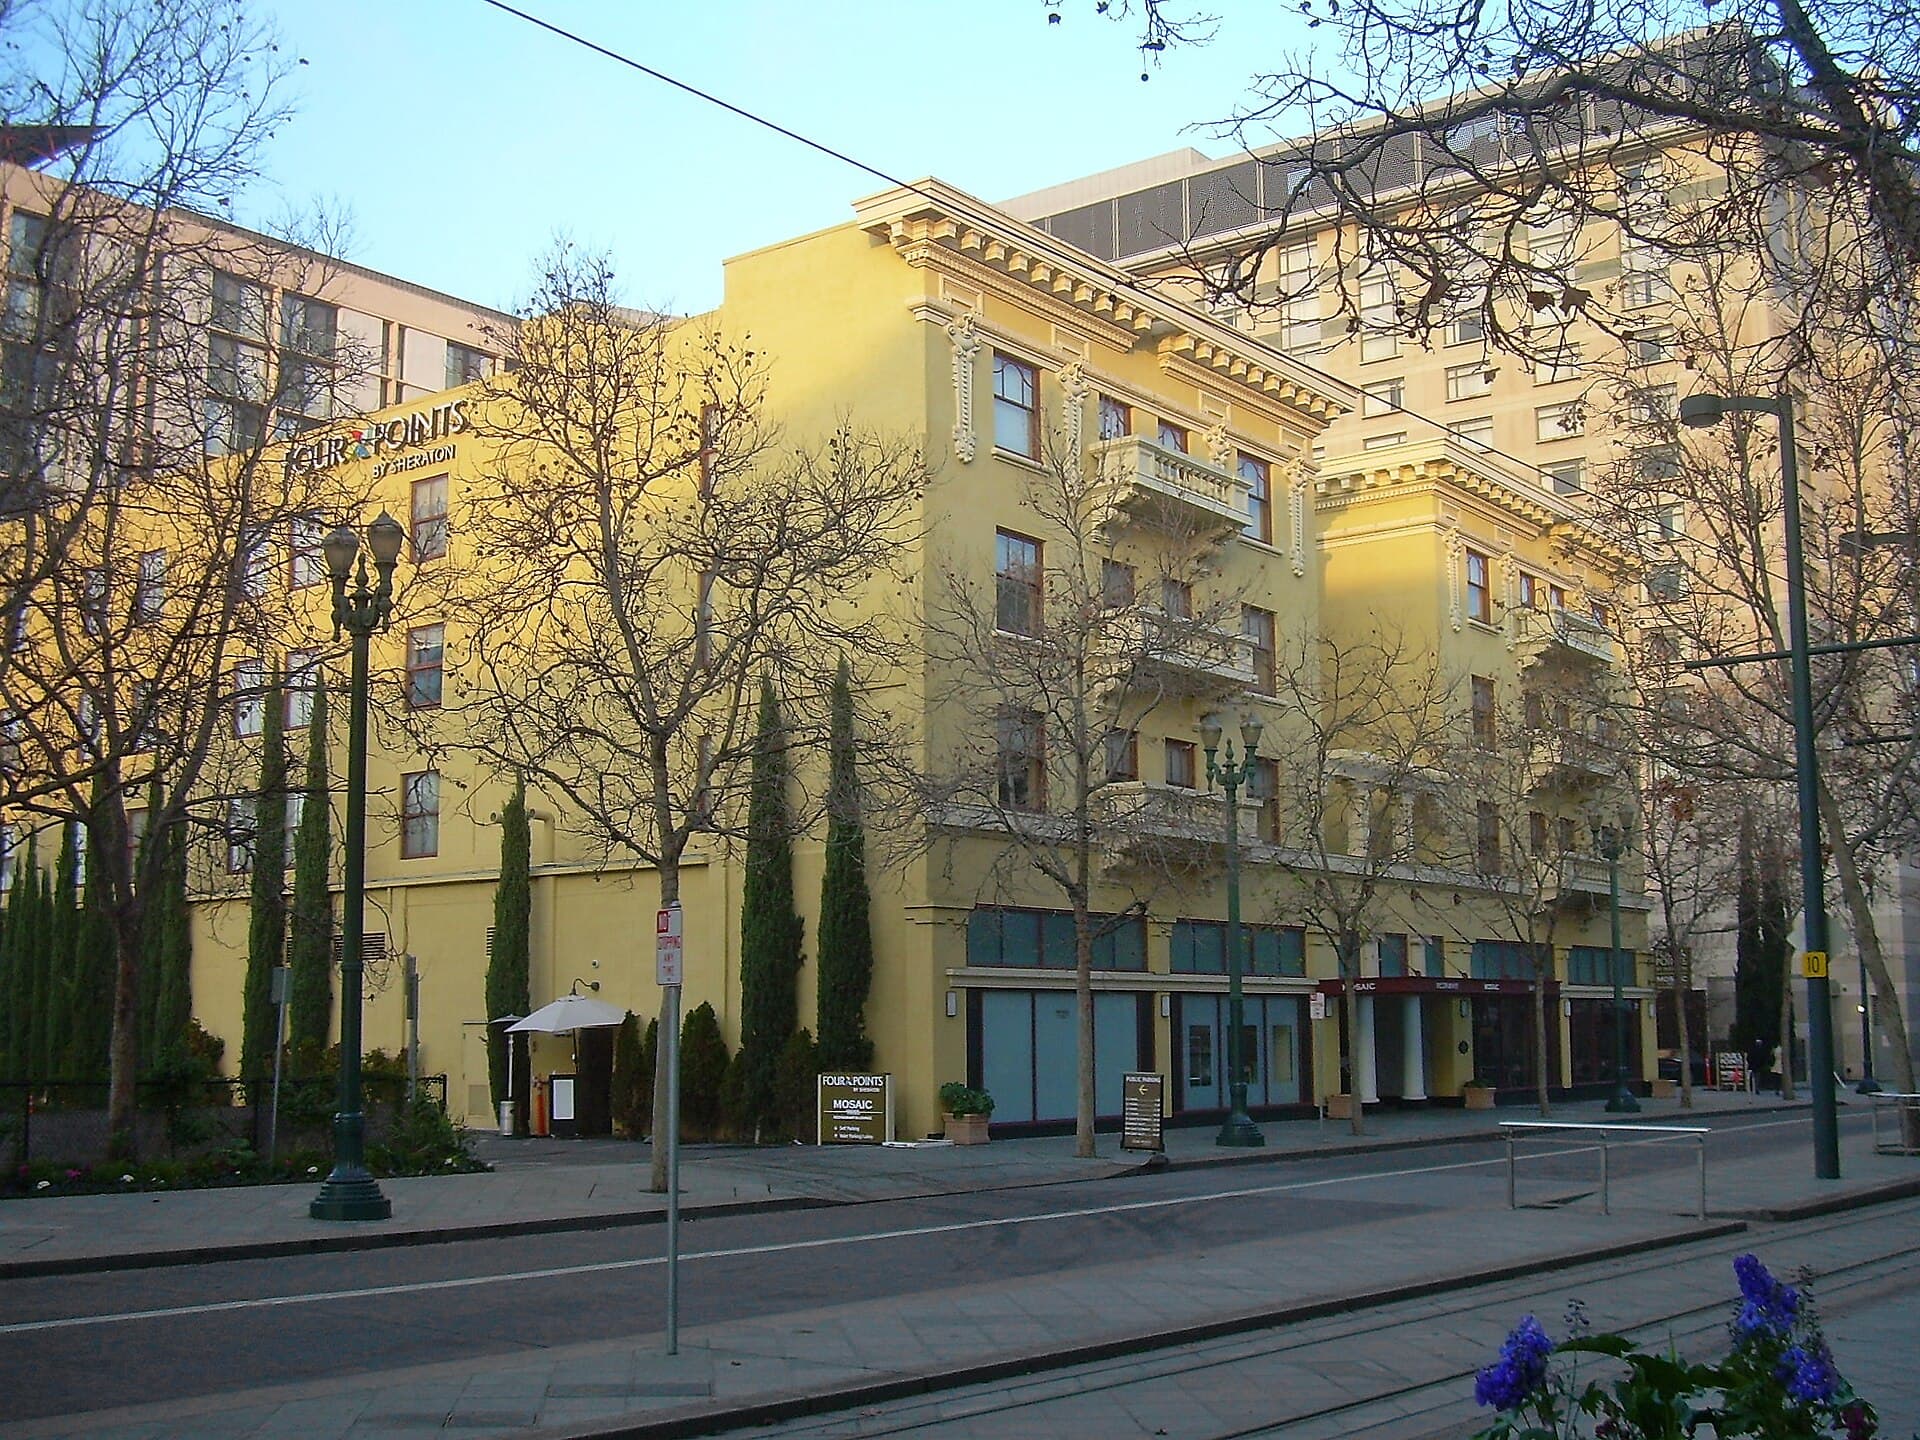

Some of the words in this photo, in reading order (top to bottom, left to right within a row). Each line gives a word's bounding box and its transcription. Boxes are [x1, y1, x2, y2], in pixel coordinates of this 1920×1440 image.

[368, 400, 469, 456] POINTS
[372, 461, 391, 479] BY
[390, 444, 457, 474] SHERATON
[1807, 956, 1820, 973] 10
[822, 1076, 846, 1086] FOUR
[853, 1076, 883, 1087] POINTS
[833, 1099, 873, 1110] MOSAIC
